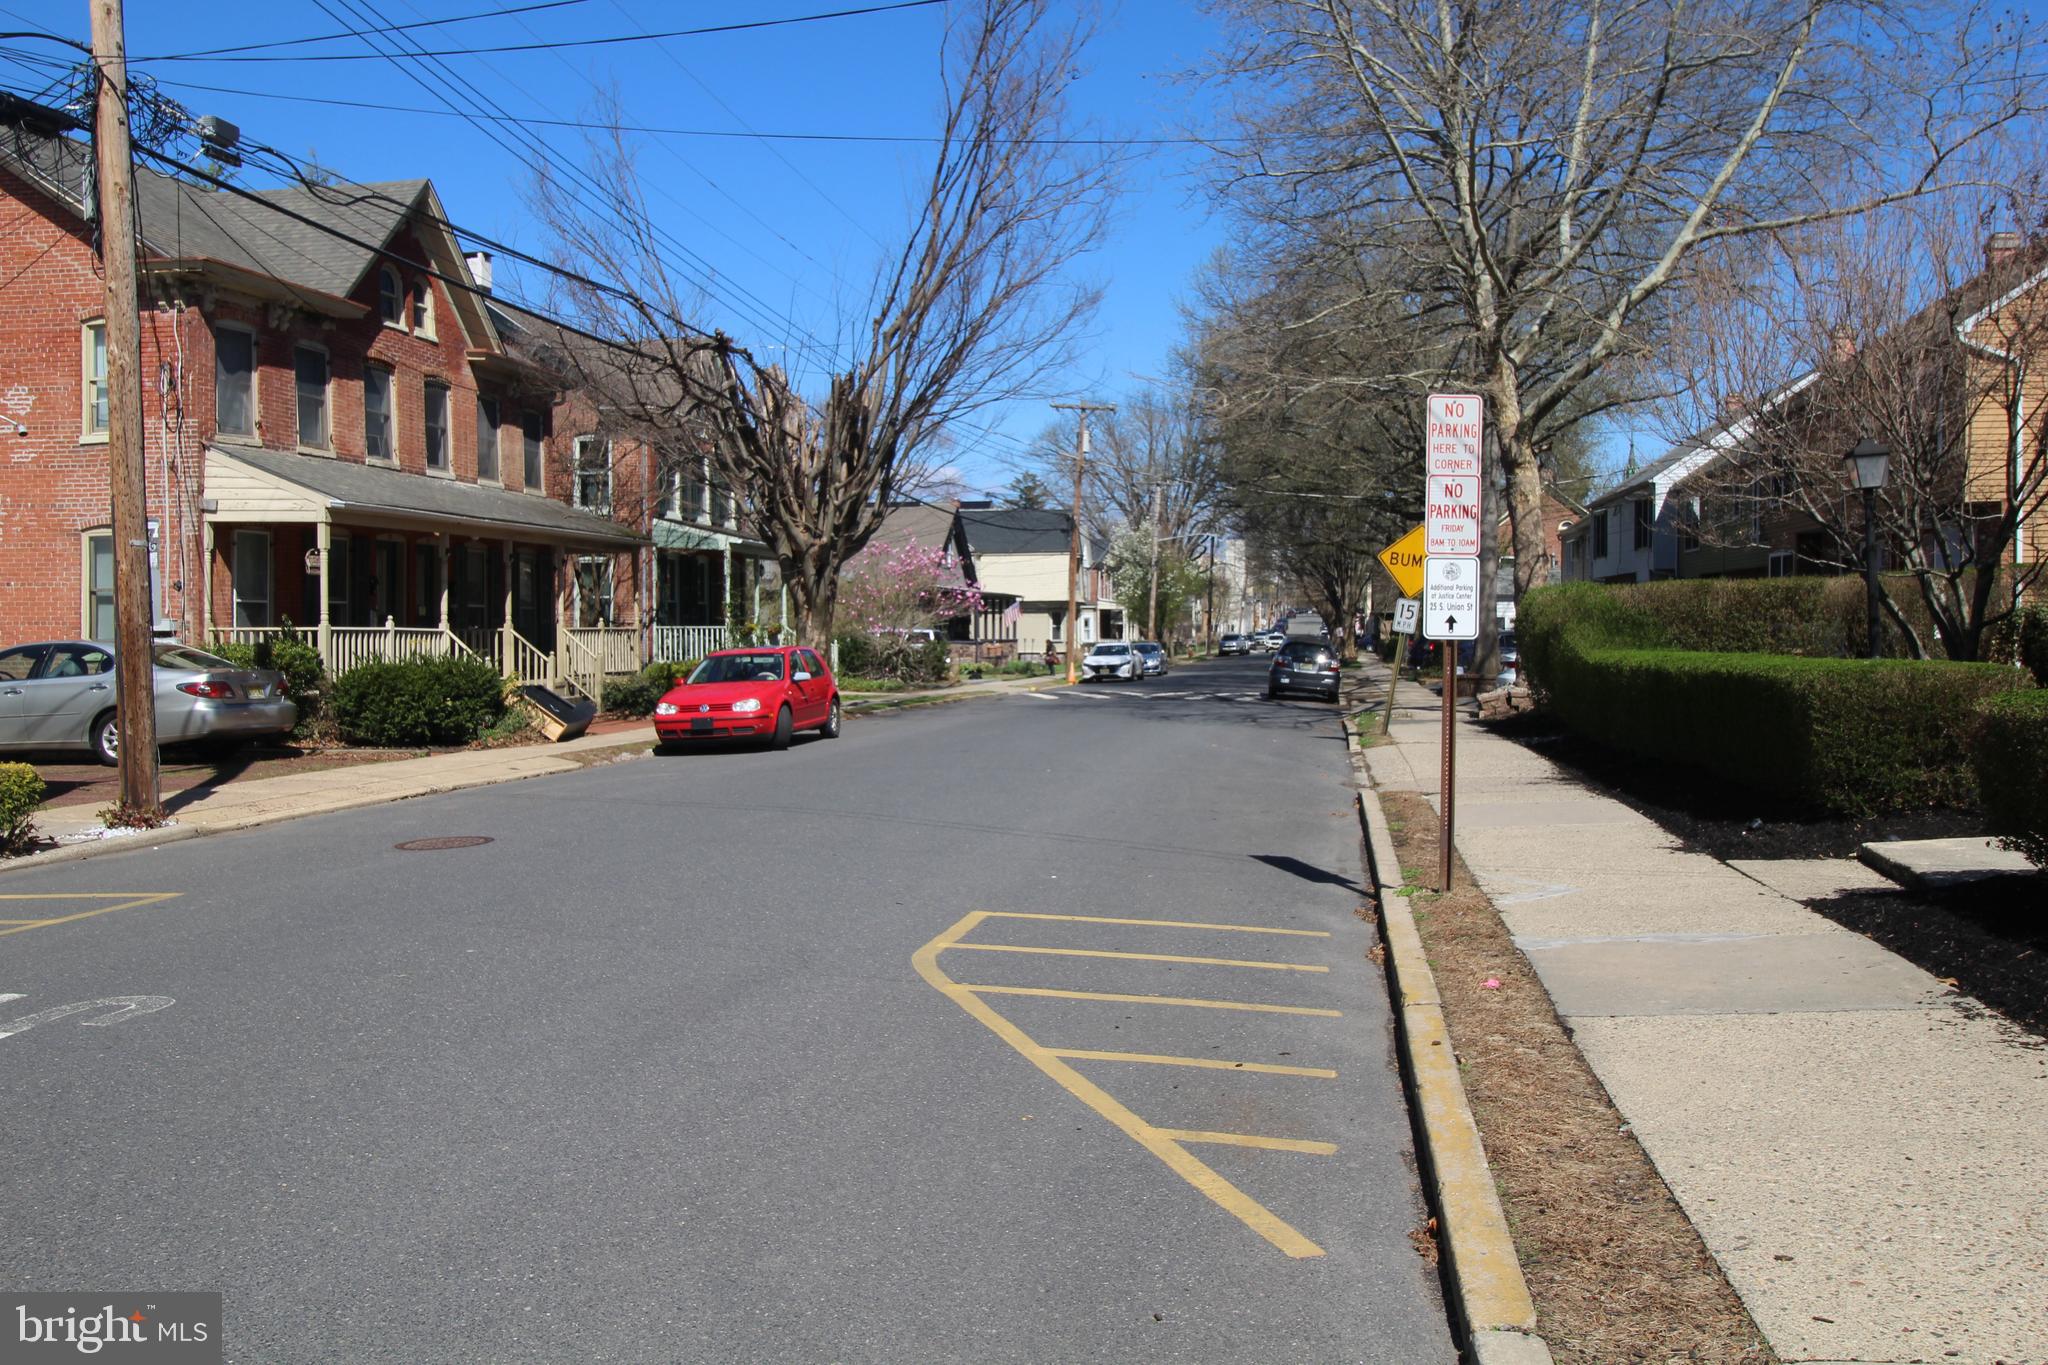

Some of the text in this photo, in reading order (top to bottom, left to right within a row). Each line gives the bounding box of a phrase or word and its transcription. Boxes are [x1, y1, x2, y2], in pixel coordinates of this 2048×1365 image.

[1445, 403, 1464, 417] NO
[1431, 423, 1477, 438] PARKING
[1433, 443, 1474, 454] HERE TO
[1435, 459, 1472, 469] CORNER
[1445, 483, 1463, 498] NO
[1430, 504, 1477, 520] PARKING
[1441, 524, 1464, 533] FRIDAY
[1431, 538, 1475, 547] 8AM TO 10AM
[1390, 552, 1424, 567] BUM
[1456, 584, 1474, 593] Parking
[1438, 592, 1455, 600] Justice
[1456, 592, 1472, 600] Center
[1400, 604, 1415, 619] 15
[1430, 602, 1437, 611] 25
[1447, 602, 1464, 611] Union
[1397, 621, 1411, 629] MPH
